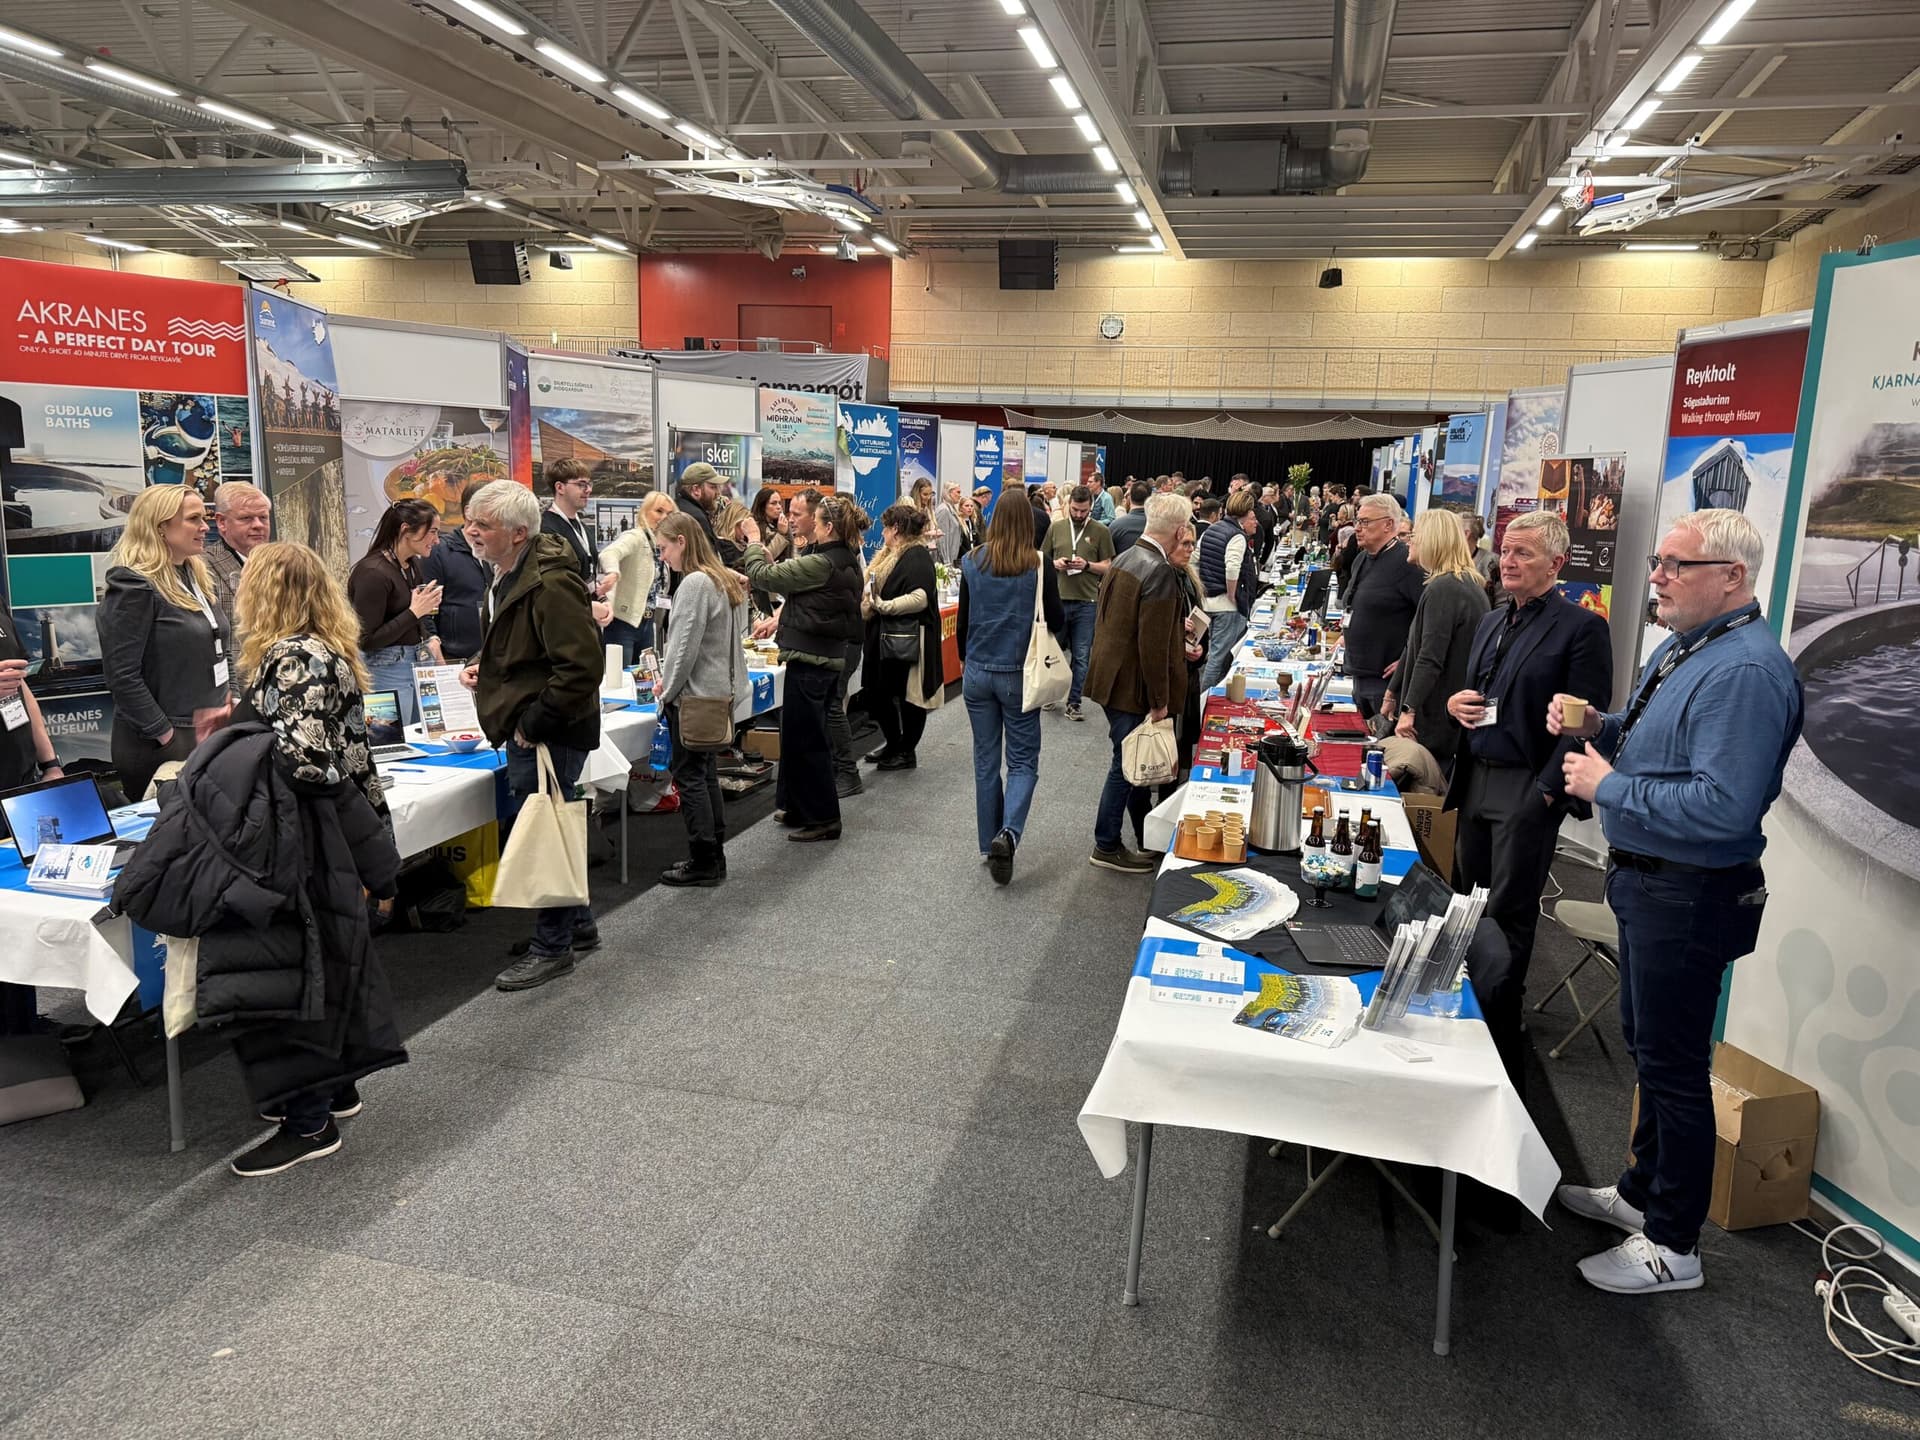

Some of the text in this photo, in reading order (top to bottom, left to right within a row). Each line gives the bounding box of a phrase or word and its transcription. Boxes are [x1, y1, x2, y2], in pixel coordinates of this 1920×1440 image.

[17, 299, 147, 333] AKRANES
[35, 330, 49, 345] A
[54, 332, 124, 350] PERFECT
[131, 338, 167, 353] DAY
[171, 341, 217, 358] TOUR
[19, 345, 40, 353] ONLY
[49, 347, 72, 355] SHORT
[83, 350, 109, 358] MINUTE
[109, 352, 129, 360] DRIVE
[129, 353, 149, 361] FROM
[1685, 362, 1737, 389] Reykholt
[1683, 394, 1730, 409] Sögustaðurinn
[44, 404, 113, 419] GUÐLAUG
[1681, 410, 1761, 425] Walking through History
[45, 416, 91, 430] BATHS
[365, 426, 426, 439] MATARLIST
[706, 442, 736, 464] sker
